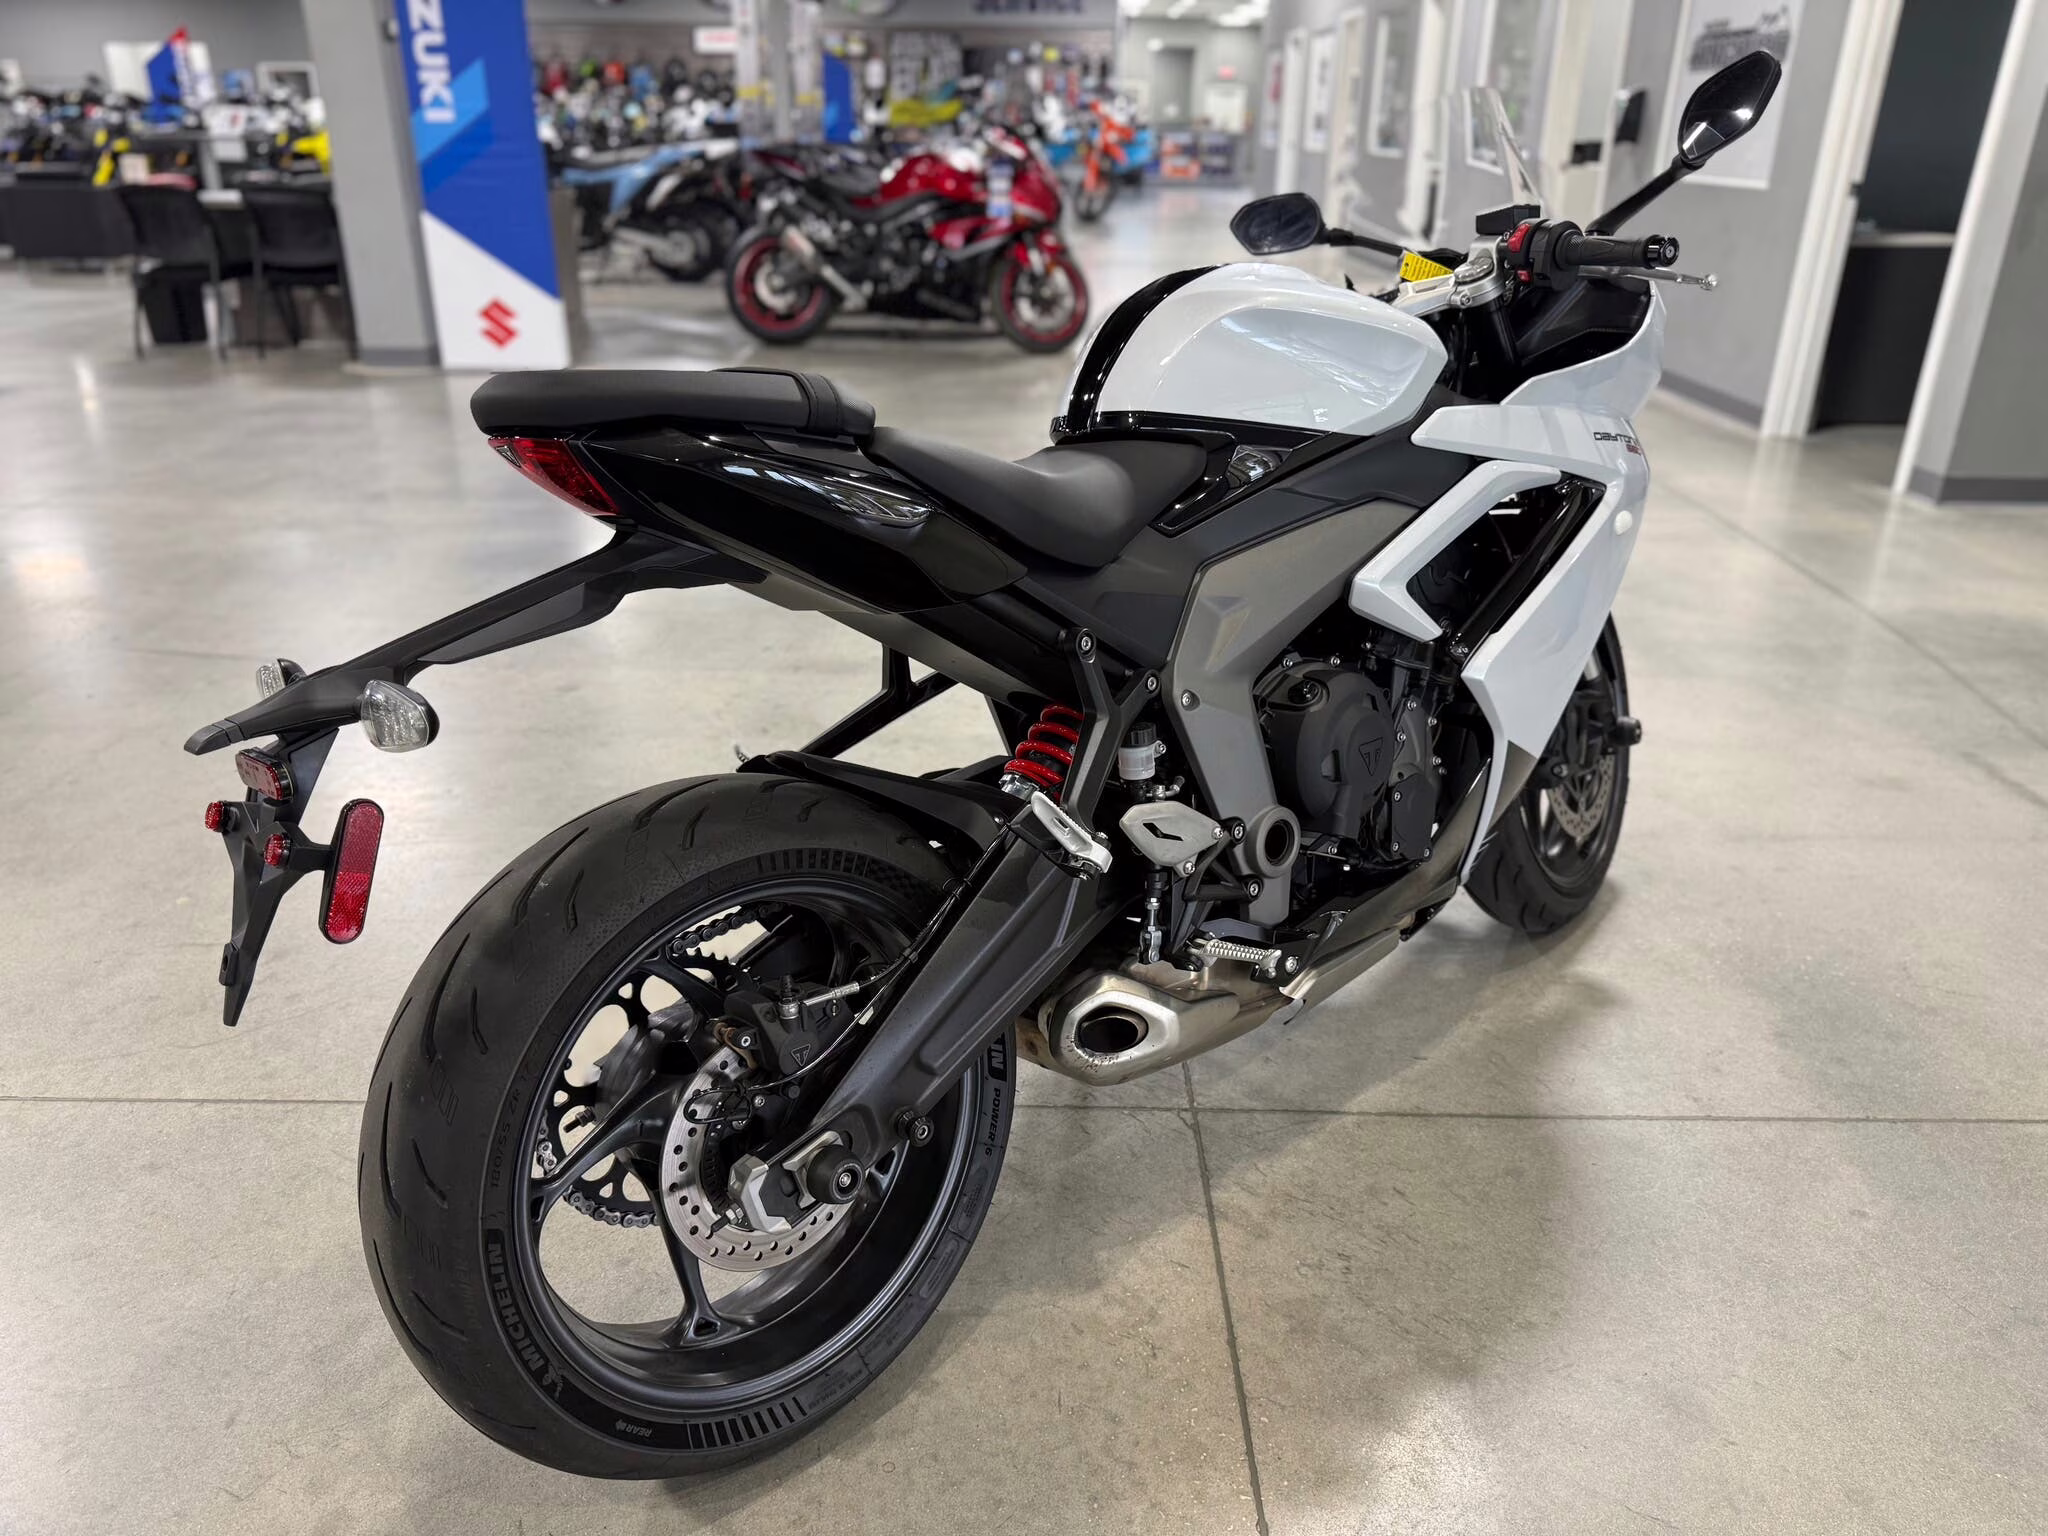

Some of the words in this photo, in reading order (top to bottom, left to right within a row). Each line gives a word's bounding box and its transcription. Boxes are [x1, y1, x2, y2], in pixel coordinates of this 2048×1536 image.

[407, 0, 456, 123] ZUKI
[987, 1087, 1001, 1142] POWER
[487, 1241, 546, 1372] MICHELIN
[625, 1423, 653, 1438] REAR
